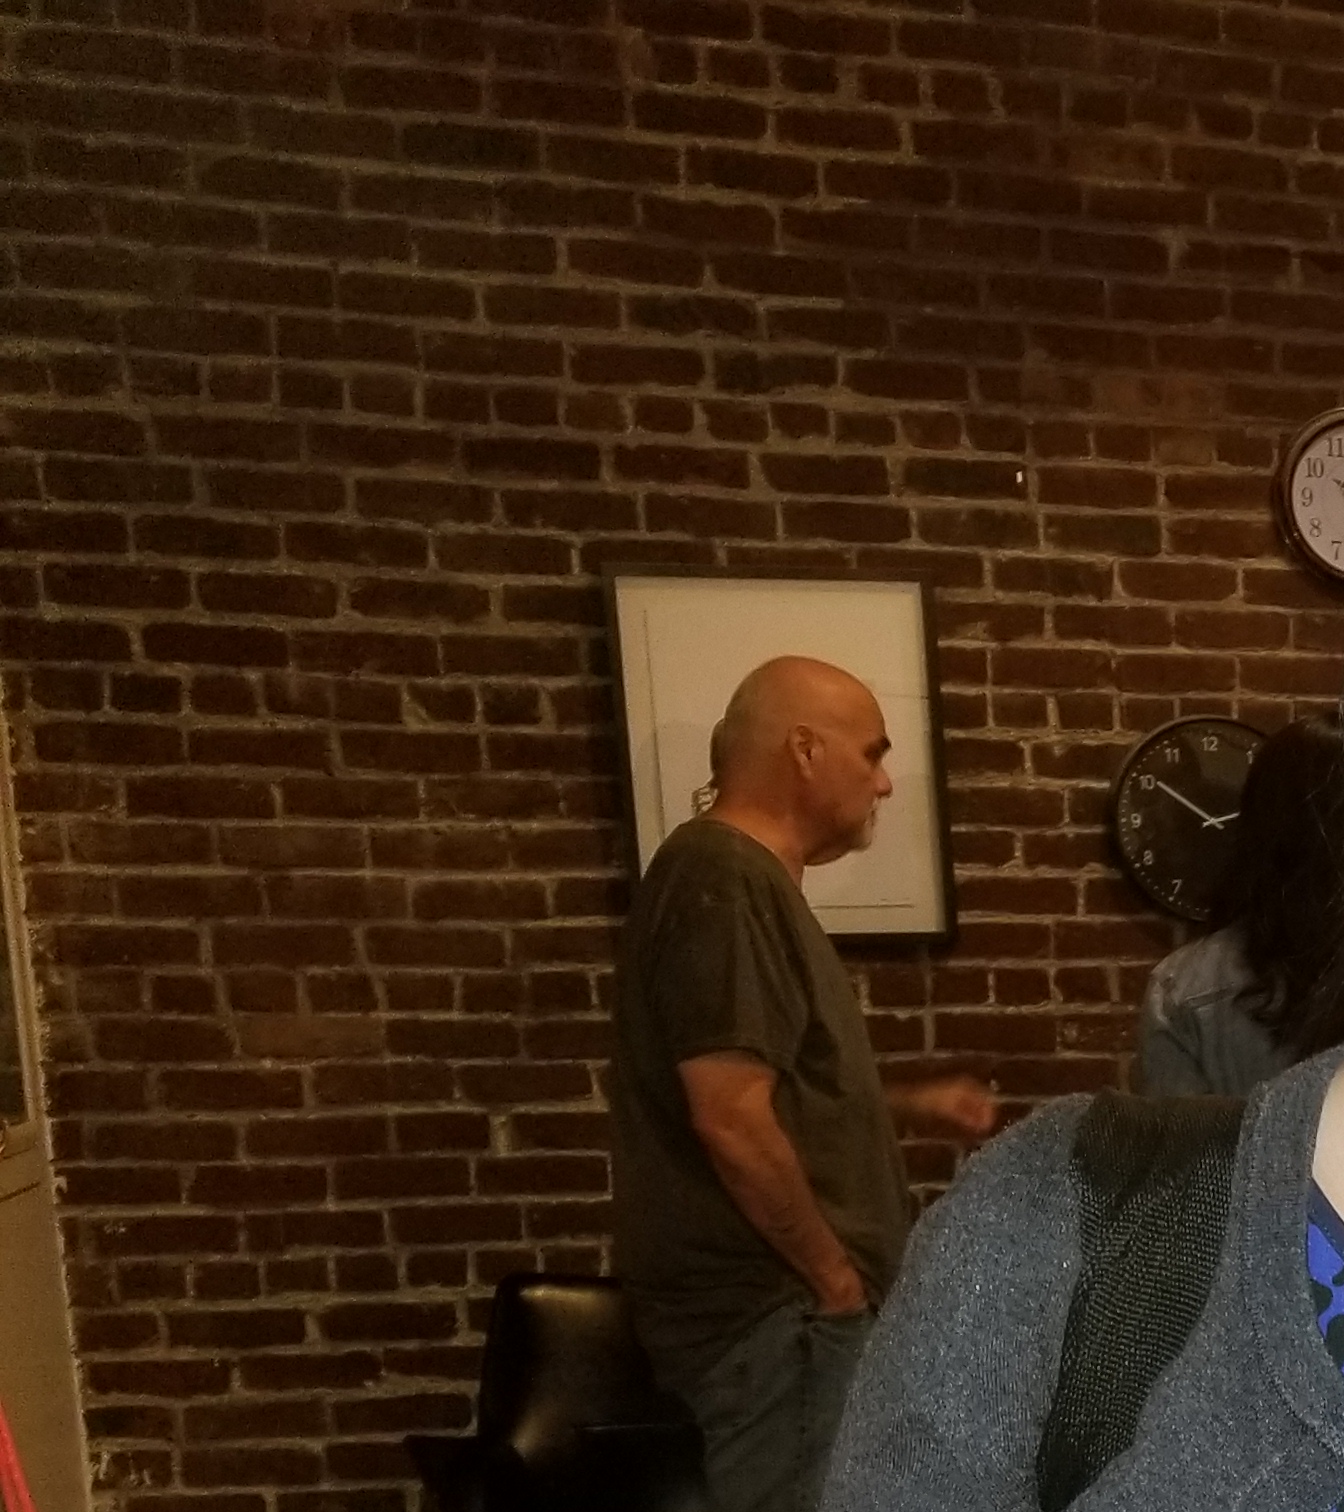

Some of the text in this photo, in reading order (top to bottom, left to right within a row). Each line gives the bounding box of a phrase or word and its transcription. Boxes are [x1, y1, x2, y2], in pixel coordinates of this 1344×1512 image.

[1327, 438, 1344, 458] 11
[1305, 457, 1324, 478] 10
[1302, 487, 1313, 507] 9
[1310, 517, 1321, 537] 8
[1331, 540, 1342, 560] 7
[1201, 736, 1218, 752] 12
[1164, 747, 1180, 764] 11
[1246, 750, 1254, 765] 1
[1138, 774, 1156, 790] 10
[1130, 813, 1142, 829] 9
[1143, 849, 1153, 866] 8
[1171, 879, 1183, 894] 7
